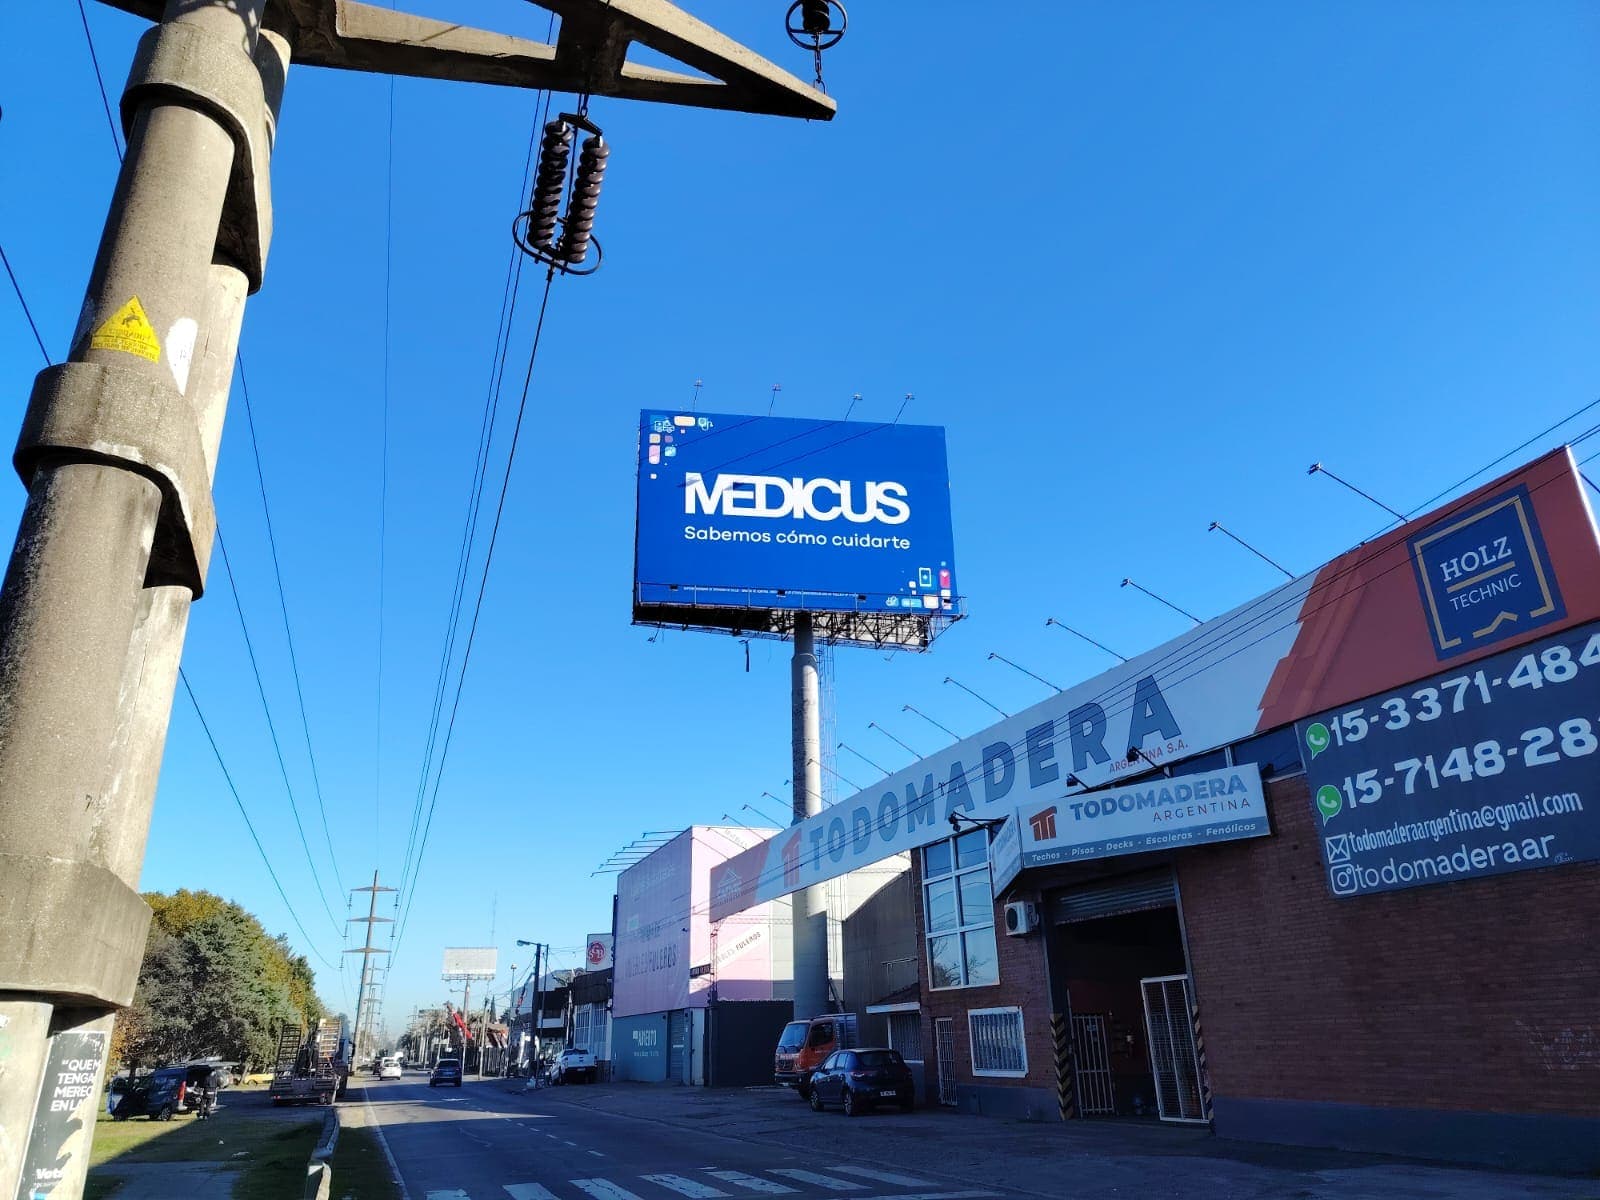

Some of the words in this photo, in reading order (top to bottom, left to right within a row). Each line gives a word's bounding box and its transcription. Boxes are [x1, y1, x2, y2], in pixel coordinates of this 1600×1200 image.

[684, 472, 911, 525] MEDICUS
[684, 526, 772, 543] Sabemos
[776, 530, 827, 546] cómo
[832, 532, 911, 550] cuidarte
[1440, 536, 1512, 582] HOLZ
[1450, 573, 1522, 611] TECHNIC
[1166, 738, 1189, 754] S.A.
[1343, 717, 1600, 809] 15-7148-28
[809, 674, 1182, 873] TODOMADERA
[1069, 774, 1248, 821] TODOMADERA
[1153, 798, 1251, 823] ARGENTINA
[1032, 851, 1060, 862] Techos
[1071, 847, 1095, 856] Pisos
[1106, 840, 1134, 851] Decks
[1146, 832, 1193, 845] Escaleras
[1206, 823, 1256, 837] Fenólicos
[1349, 791, 1584, 853] todomaderaargentina@gmail.com
[1355, 834, 1555, 889] todomaderaar
[50, 1099, 69, 1112] EN
